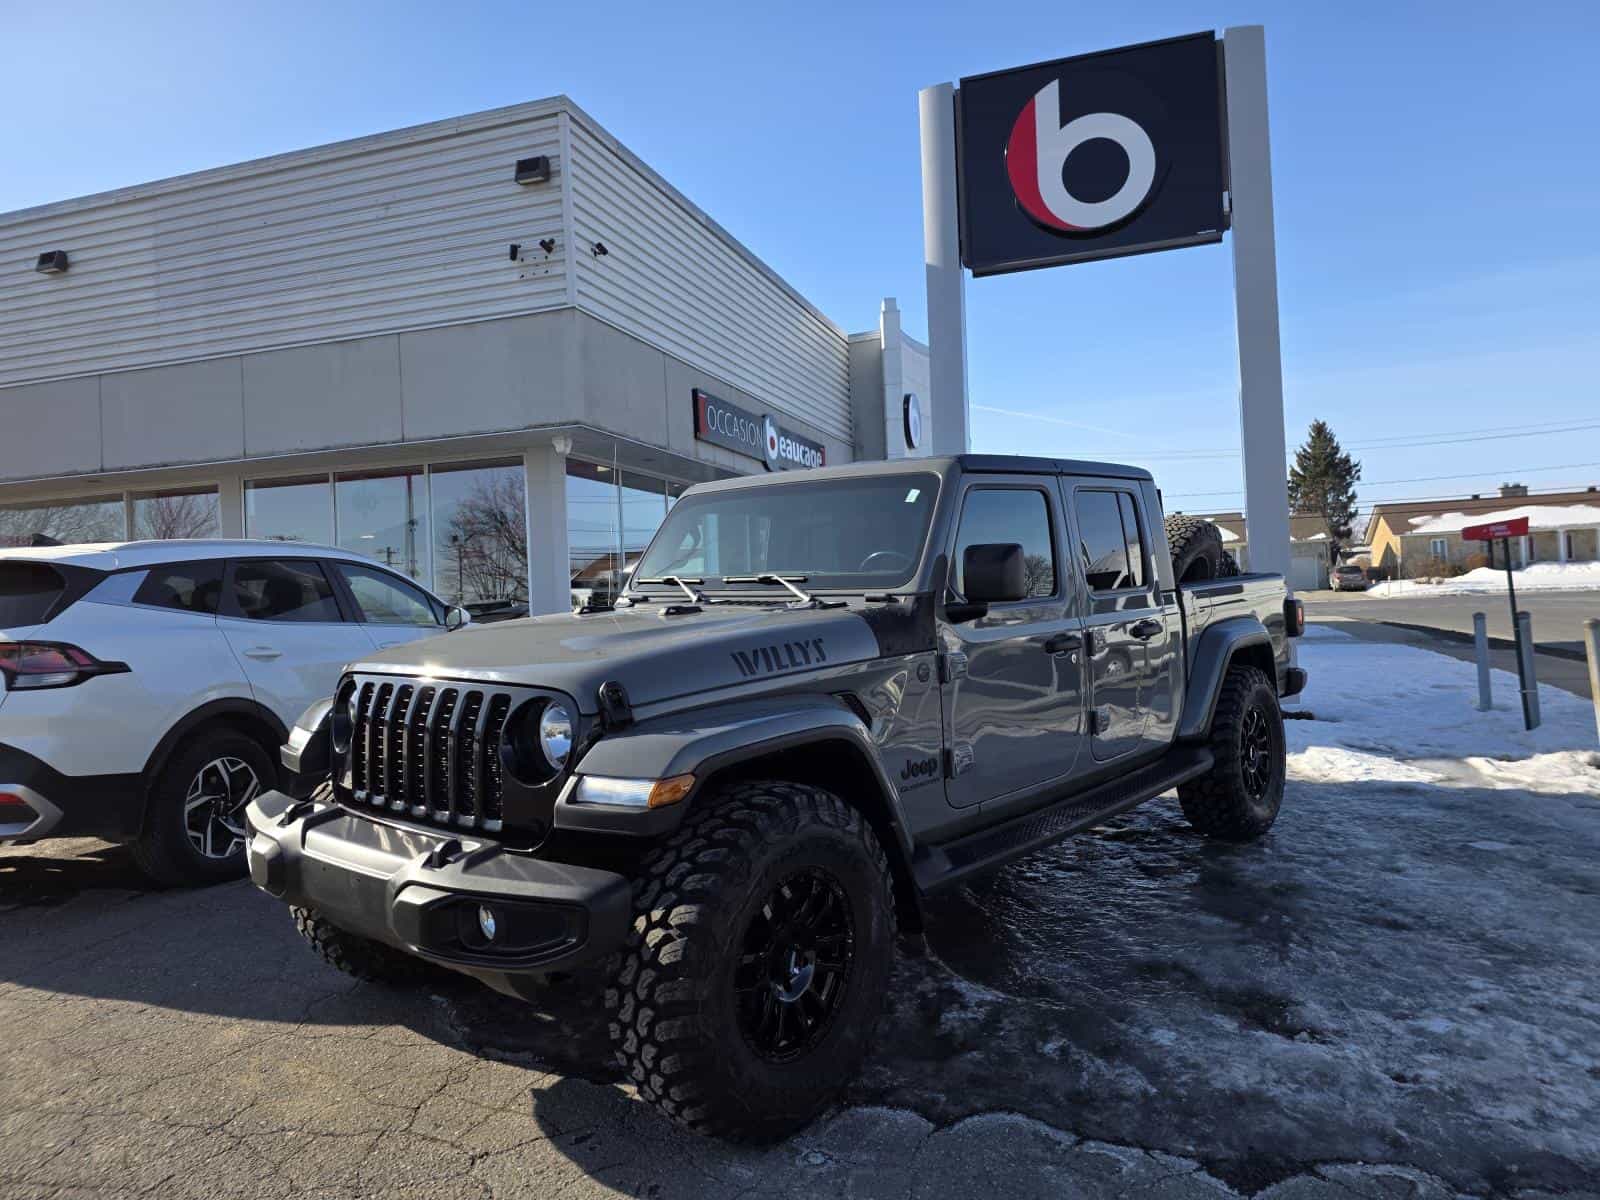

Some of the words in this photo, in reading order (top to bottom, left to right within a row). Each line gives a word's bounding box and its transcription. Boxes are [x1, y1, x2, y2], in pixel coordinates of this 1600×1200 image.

[1033, 78, 1156, 229] b
[707, 405, 763, 449] OCCASION
[765, 417, 822, 468] beaucage
[730, 638, 827, 677] WILLYS
[900, 758, 938, 780] Jeep
